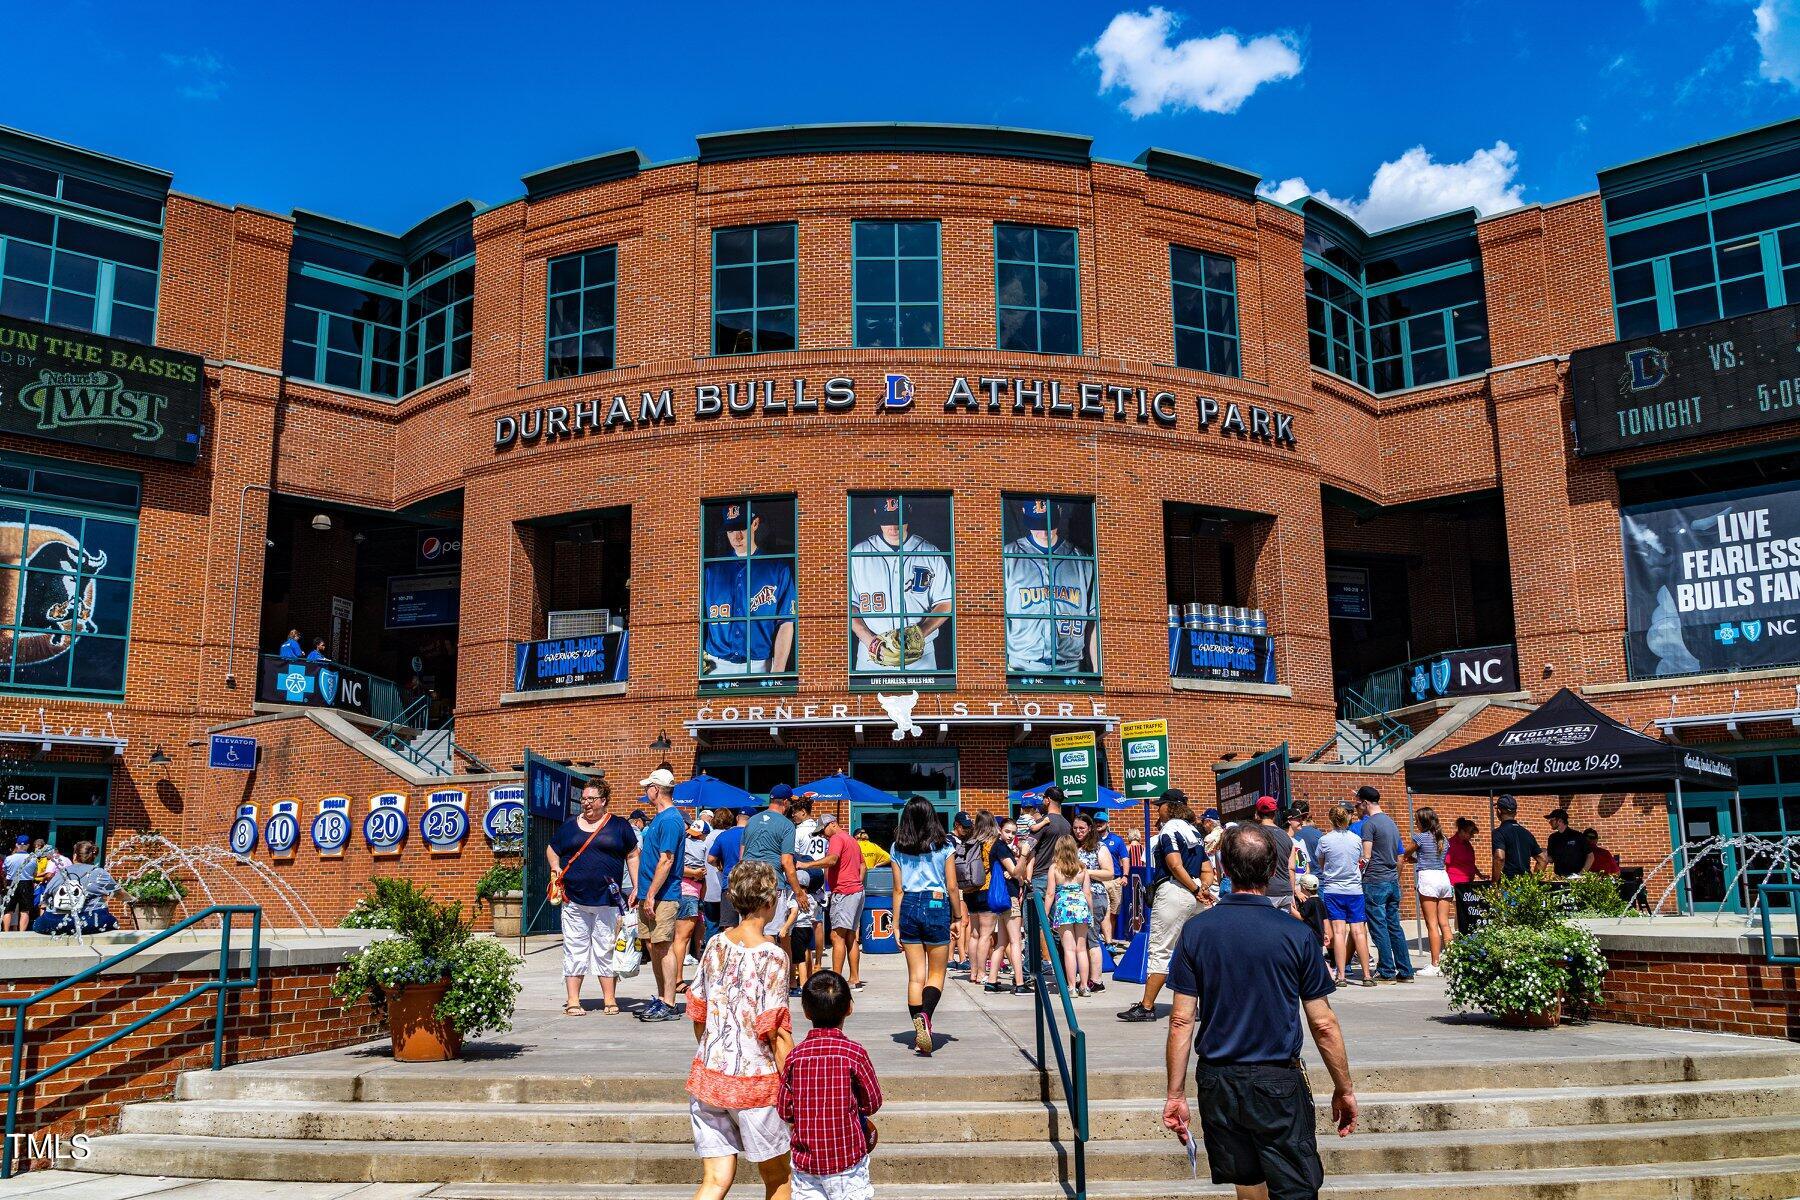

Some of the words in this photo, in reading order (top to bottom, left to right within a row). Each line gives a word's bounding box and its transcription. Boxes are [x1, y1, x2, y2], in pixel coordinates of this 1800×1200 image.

[17, 355, 36, 368] BY
[44, 337, 102, 364] THE
[110, 350, 197, 383] BASES
[1708, 341, 1744, 371] VS.
[494, 388, 676, 448] DURHAM
[695, 376, 856, 416] BULLS
[944, 375, 1177, 424] ATHLETIC
[1197, 396, 1297, 444] PARK
[1616, 396, 1702, 437] TONIGHT
[1717, 508, 1772, 543] LIVE
[860, 591, 886, 613] 29
[1019, 585, 1080, 609] DURHAM
[1677, 576, 1755, 613] BULLS
[1767, 619, 1797, 637] NC
[583, 648, 597, 658] CUP
[1191, 648, 1256, 672] CHAMPIONS
[1237, 646, 1250, 656] CUP
[537, 653, 605, 678] CHAMPIONS
[1459, 658, 1504, 687] NC
[341, 678, 362, 707] NC
[870, 677, 882, 685] LIVE
[697, 703, 849, 721] CORNER
[953, 701, 1108, 717] STORE
[214, 737, 254, 745] ELEVATOR
[1506, 726, 1591, 743] KIOLBASSA
[1125, 768, 1137, 779] NO
[1138, 765, 1166, 778] BAGS
[1449, 758, 1540, 780] Slow-Crafted
[1543, 757, 1582, 774] Since
[1584, 753, 1623, 771] 1949.
[1062, 774, 1087, 785] BAGS
[8, 793, 46, 801] FLOOR
[494, 789, 524, 800] ROBINSO
[237, 822, 248, 848] 8
[269, 818, 290, 847] 10
[319, 816, 342, 843] 18
[371, 812, 400, 841] 20
[428, 809, 460, 838] 25
[809, 838, 824, 855] 39
